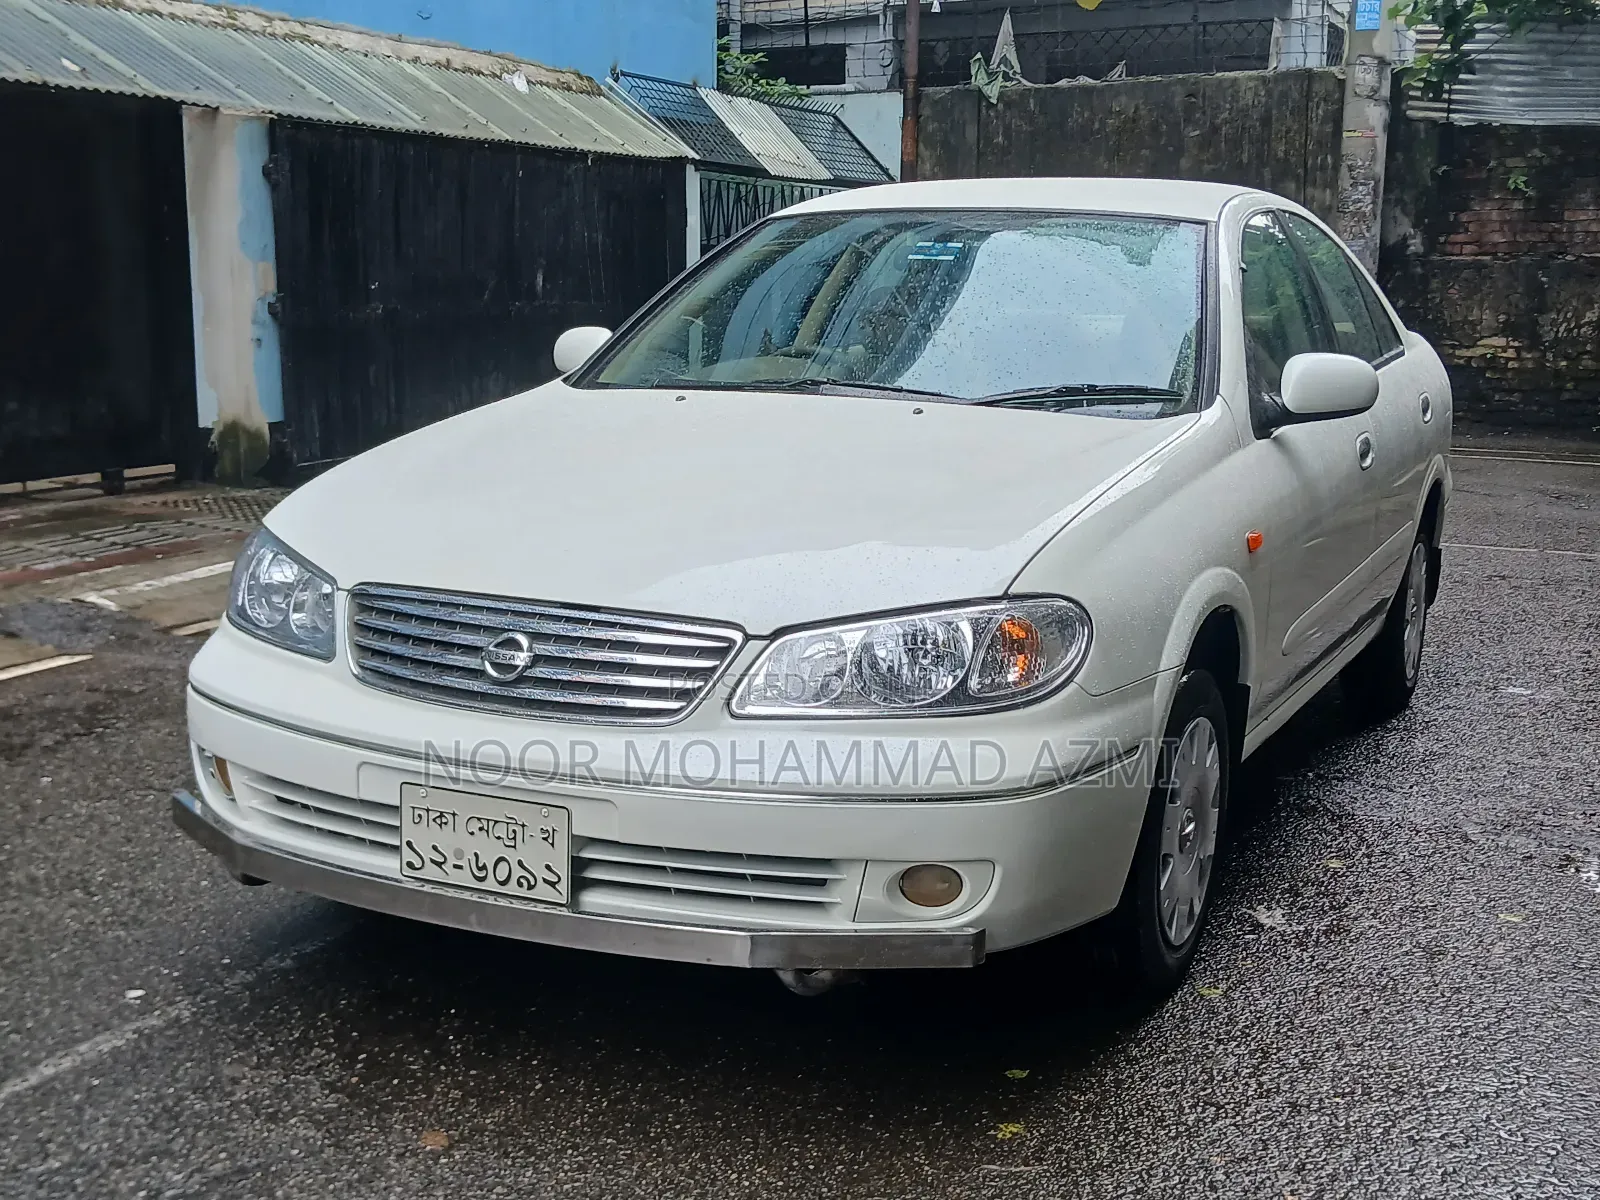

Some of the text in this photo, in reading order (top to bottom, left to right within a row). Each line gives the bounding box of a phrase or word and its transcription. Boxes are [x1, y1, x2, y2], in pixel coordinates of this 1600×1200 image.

[484, 650, 526, 665] NISSAN
[409, 805, 459, 833] ঢাকা
[405, 839, 563, 897] ১২-৬০৯২
